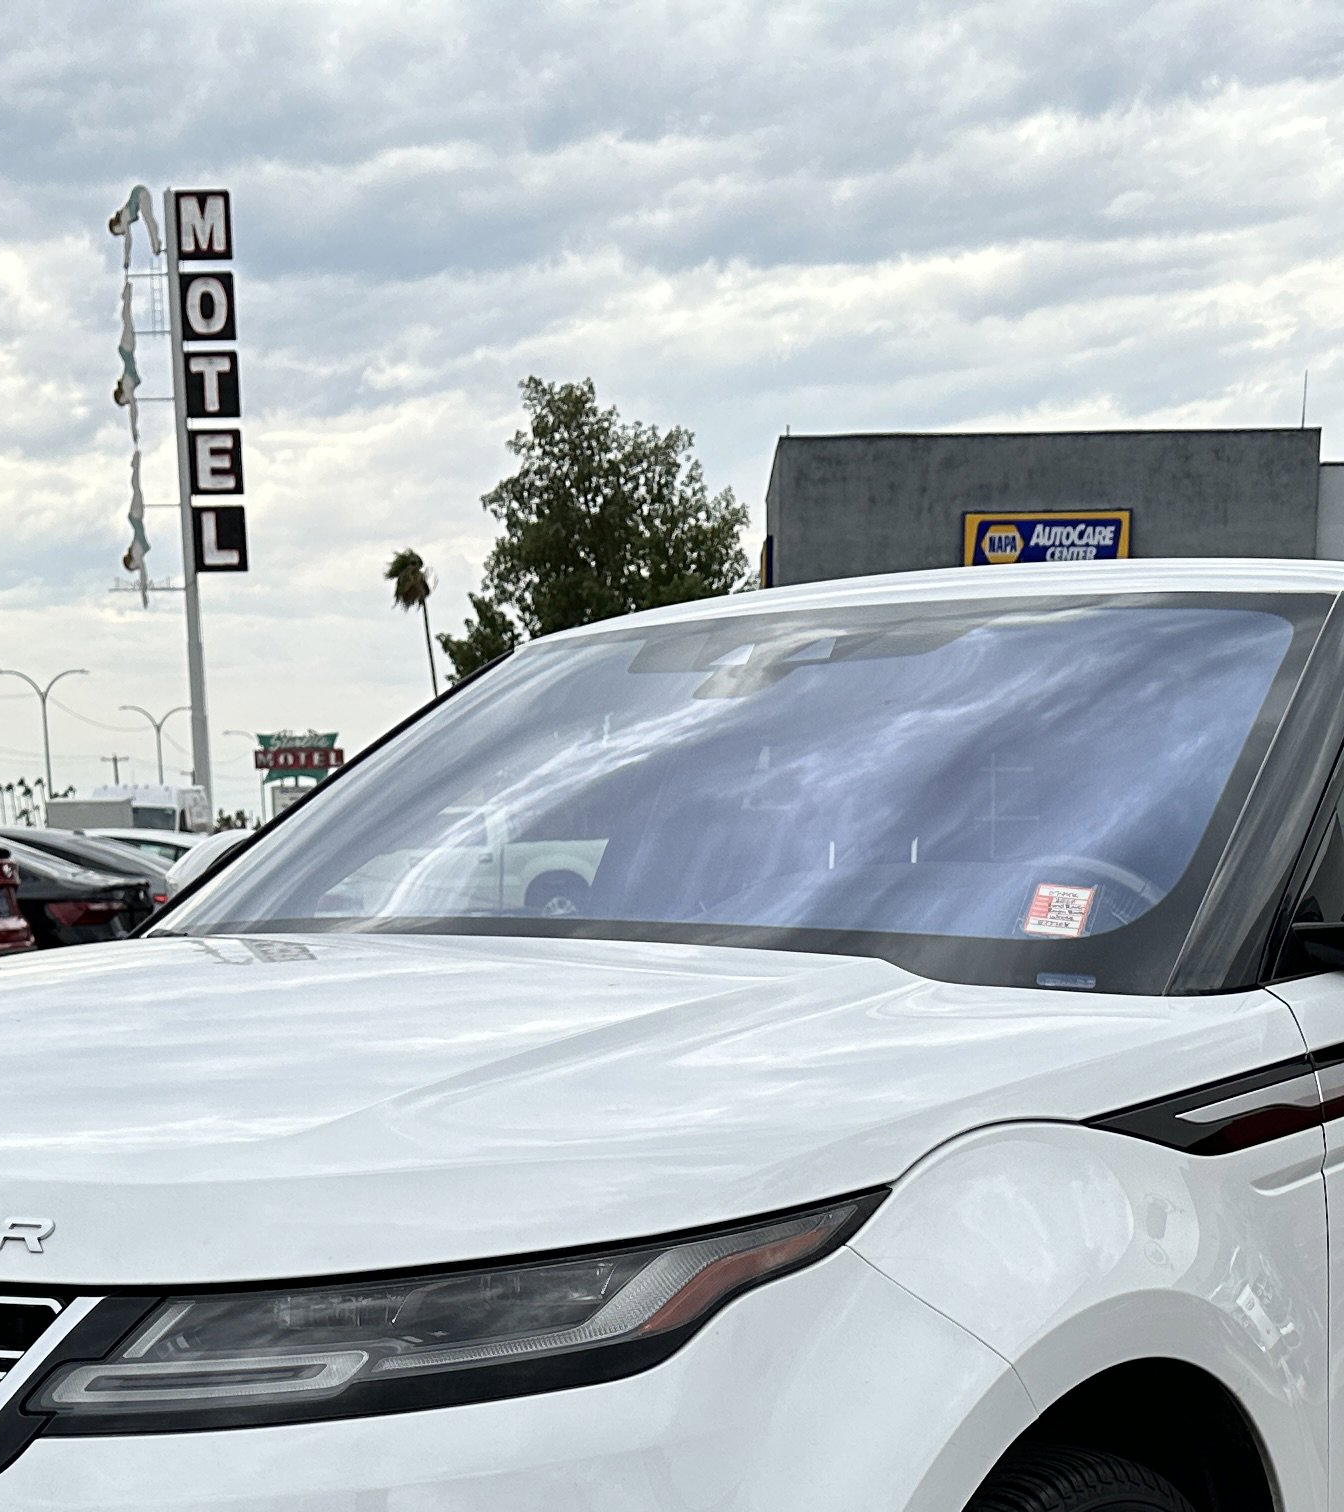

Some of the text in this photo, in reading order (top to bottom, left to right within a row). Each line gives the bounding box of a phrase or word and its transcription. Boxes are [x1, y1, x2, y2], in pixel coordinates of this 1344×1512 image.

[179, 194, 240, 566] MOTEL
[988, 534, 1018, 553] NAPA
[1045, 546, 1097, 561] CENTER
[257, 751, 344, 768] MOTEL
